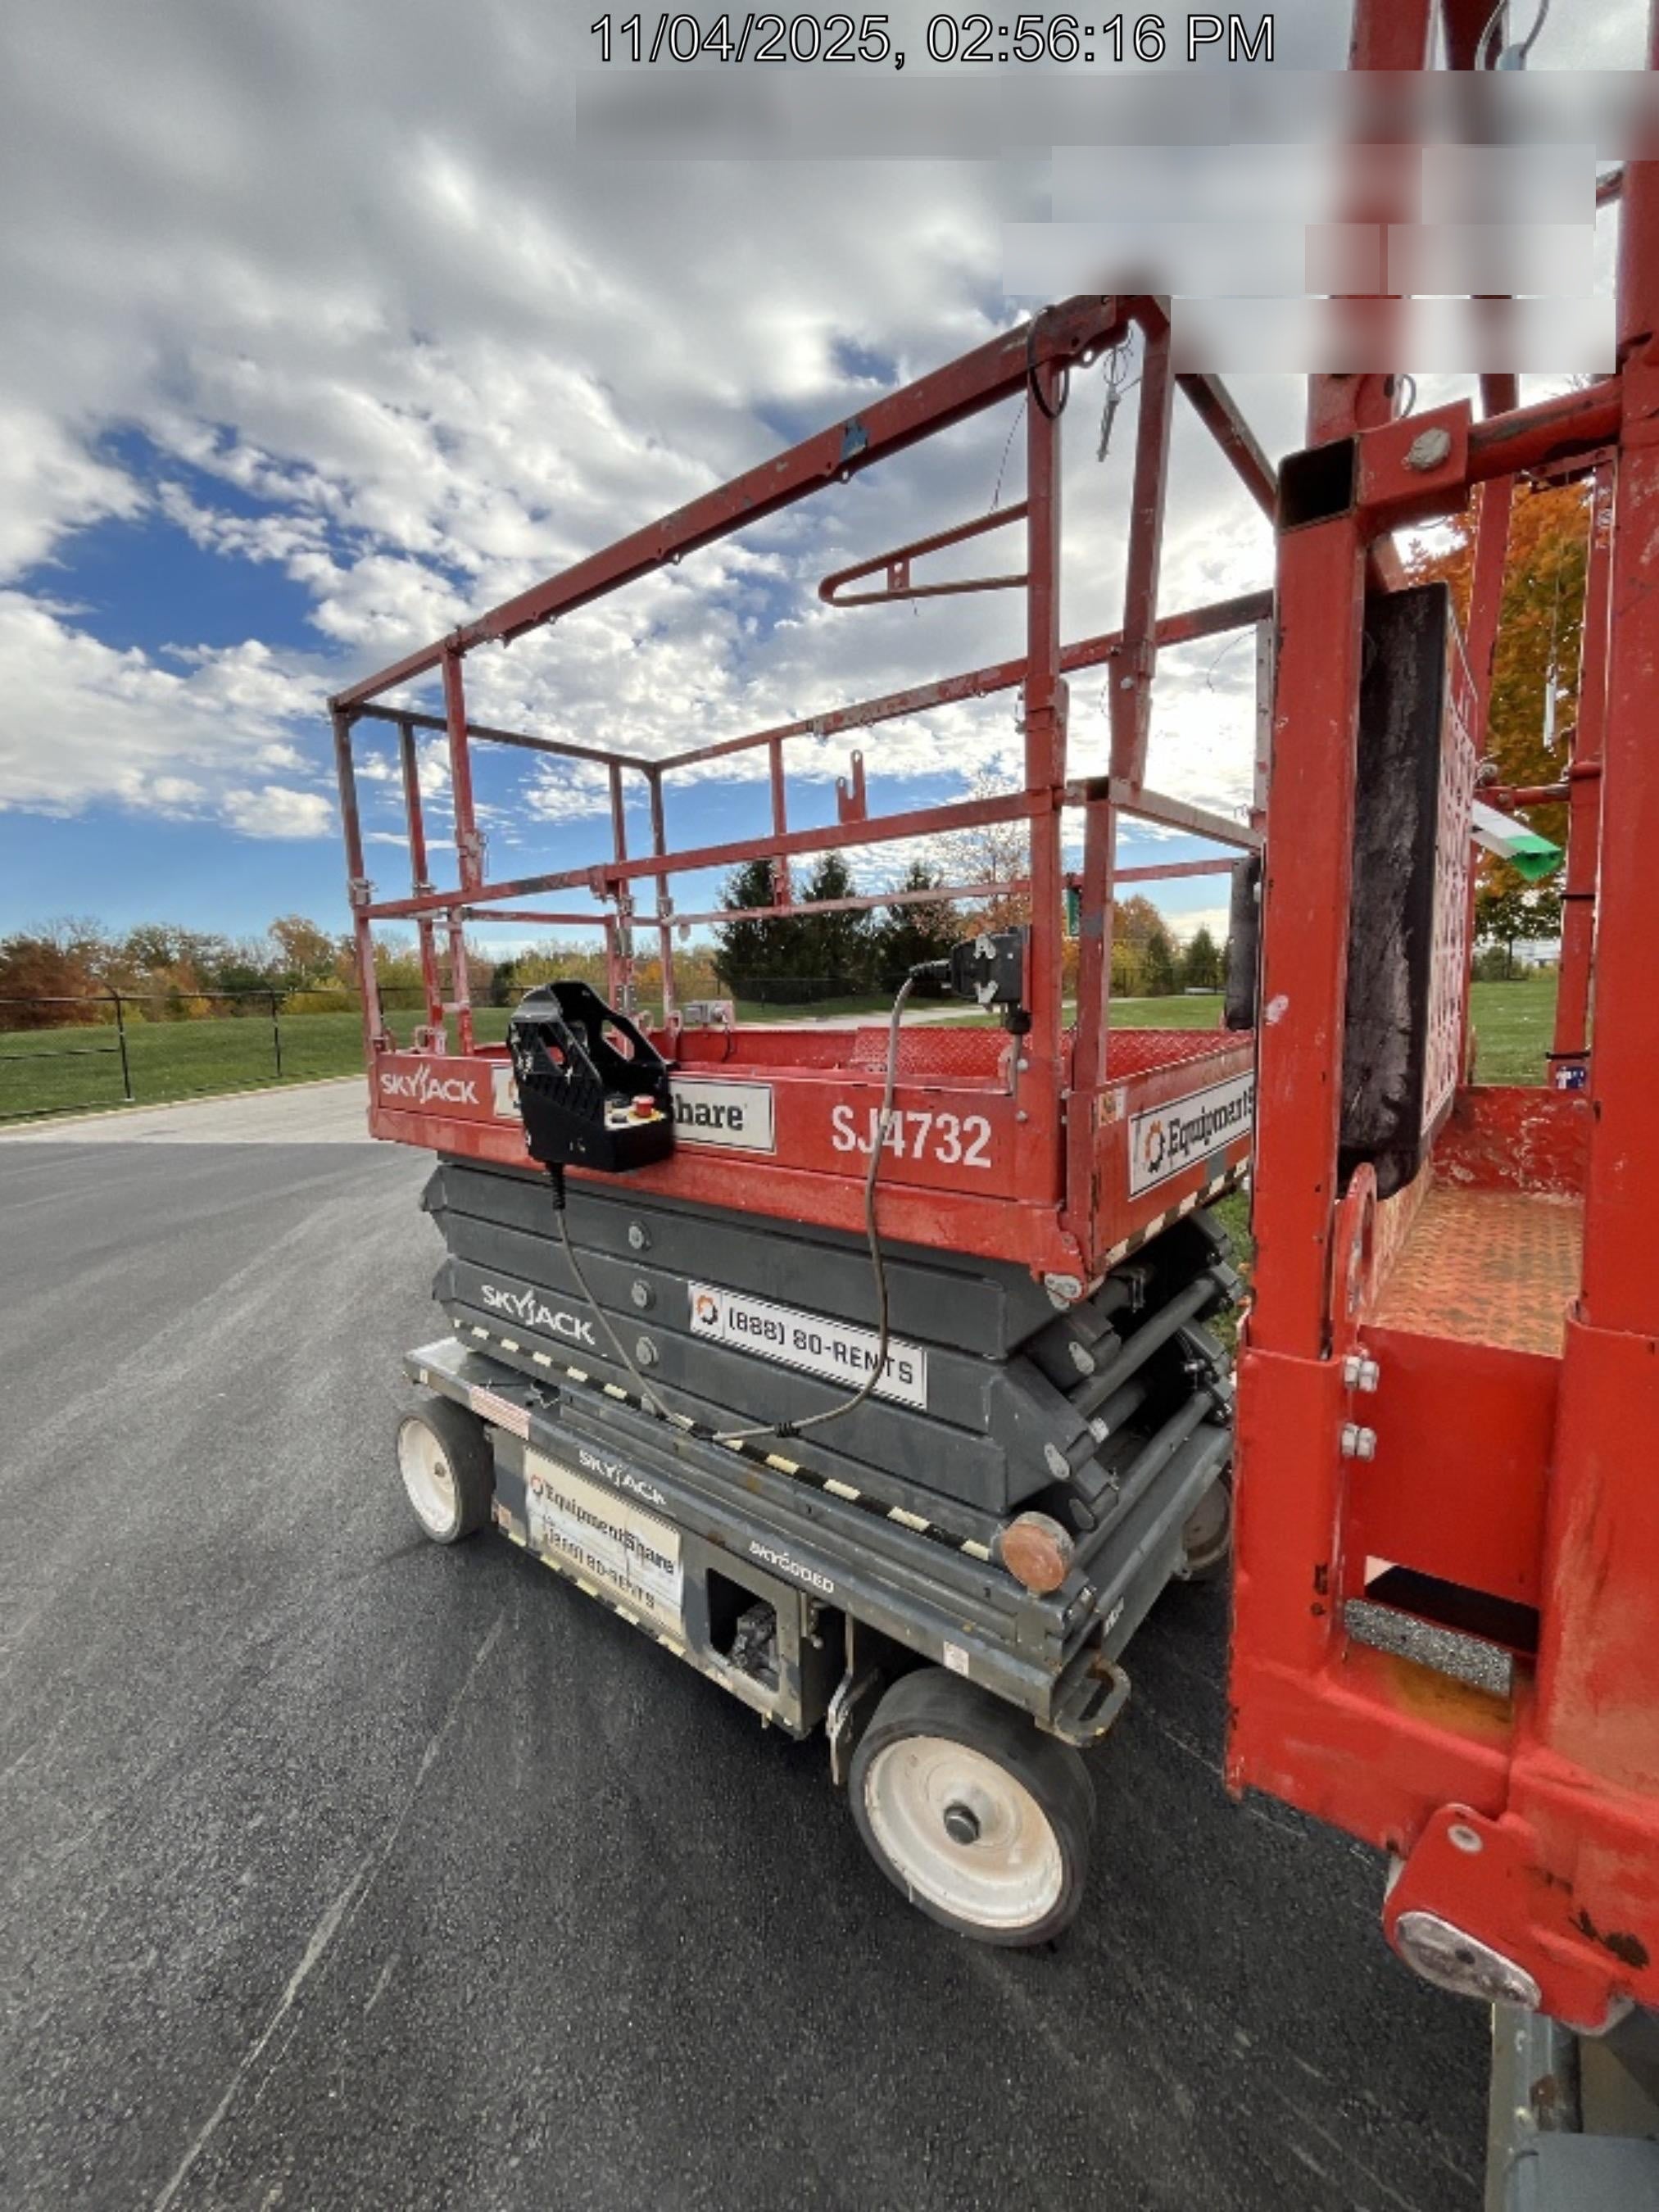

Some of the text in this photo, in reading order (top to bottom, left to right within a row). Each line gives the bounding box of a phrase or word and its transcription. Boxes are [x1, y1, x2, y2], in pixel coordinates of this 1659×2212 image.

[380, 1063, 479, 1104] SKYJACK
[674, 1093, 744, 1131] hare
[832, 1105, 992, 1168] SJ4732
[1167, 1085, 1254, 1157] EquipmentS
[481, 1284, 596, 1346] SKYJACK
[728, 1307, 913, 1385] (888) 80-RENTS
